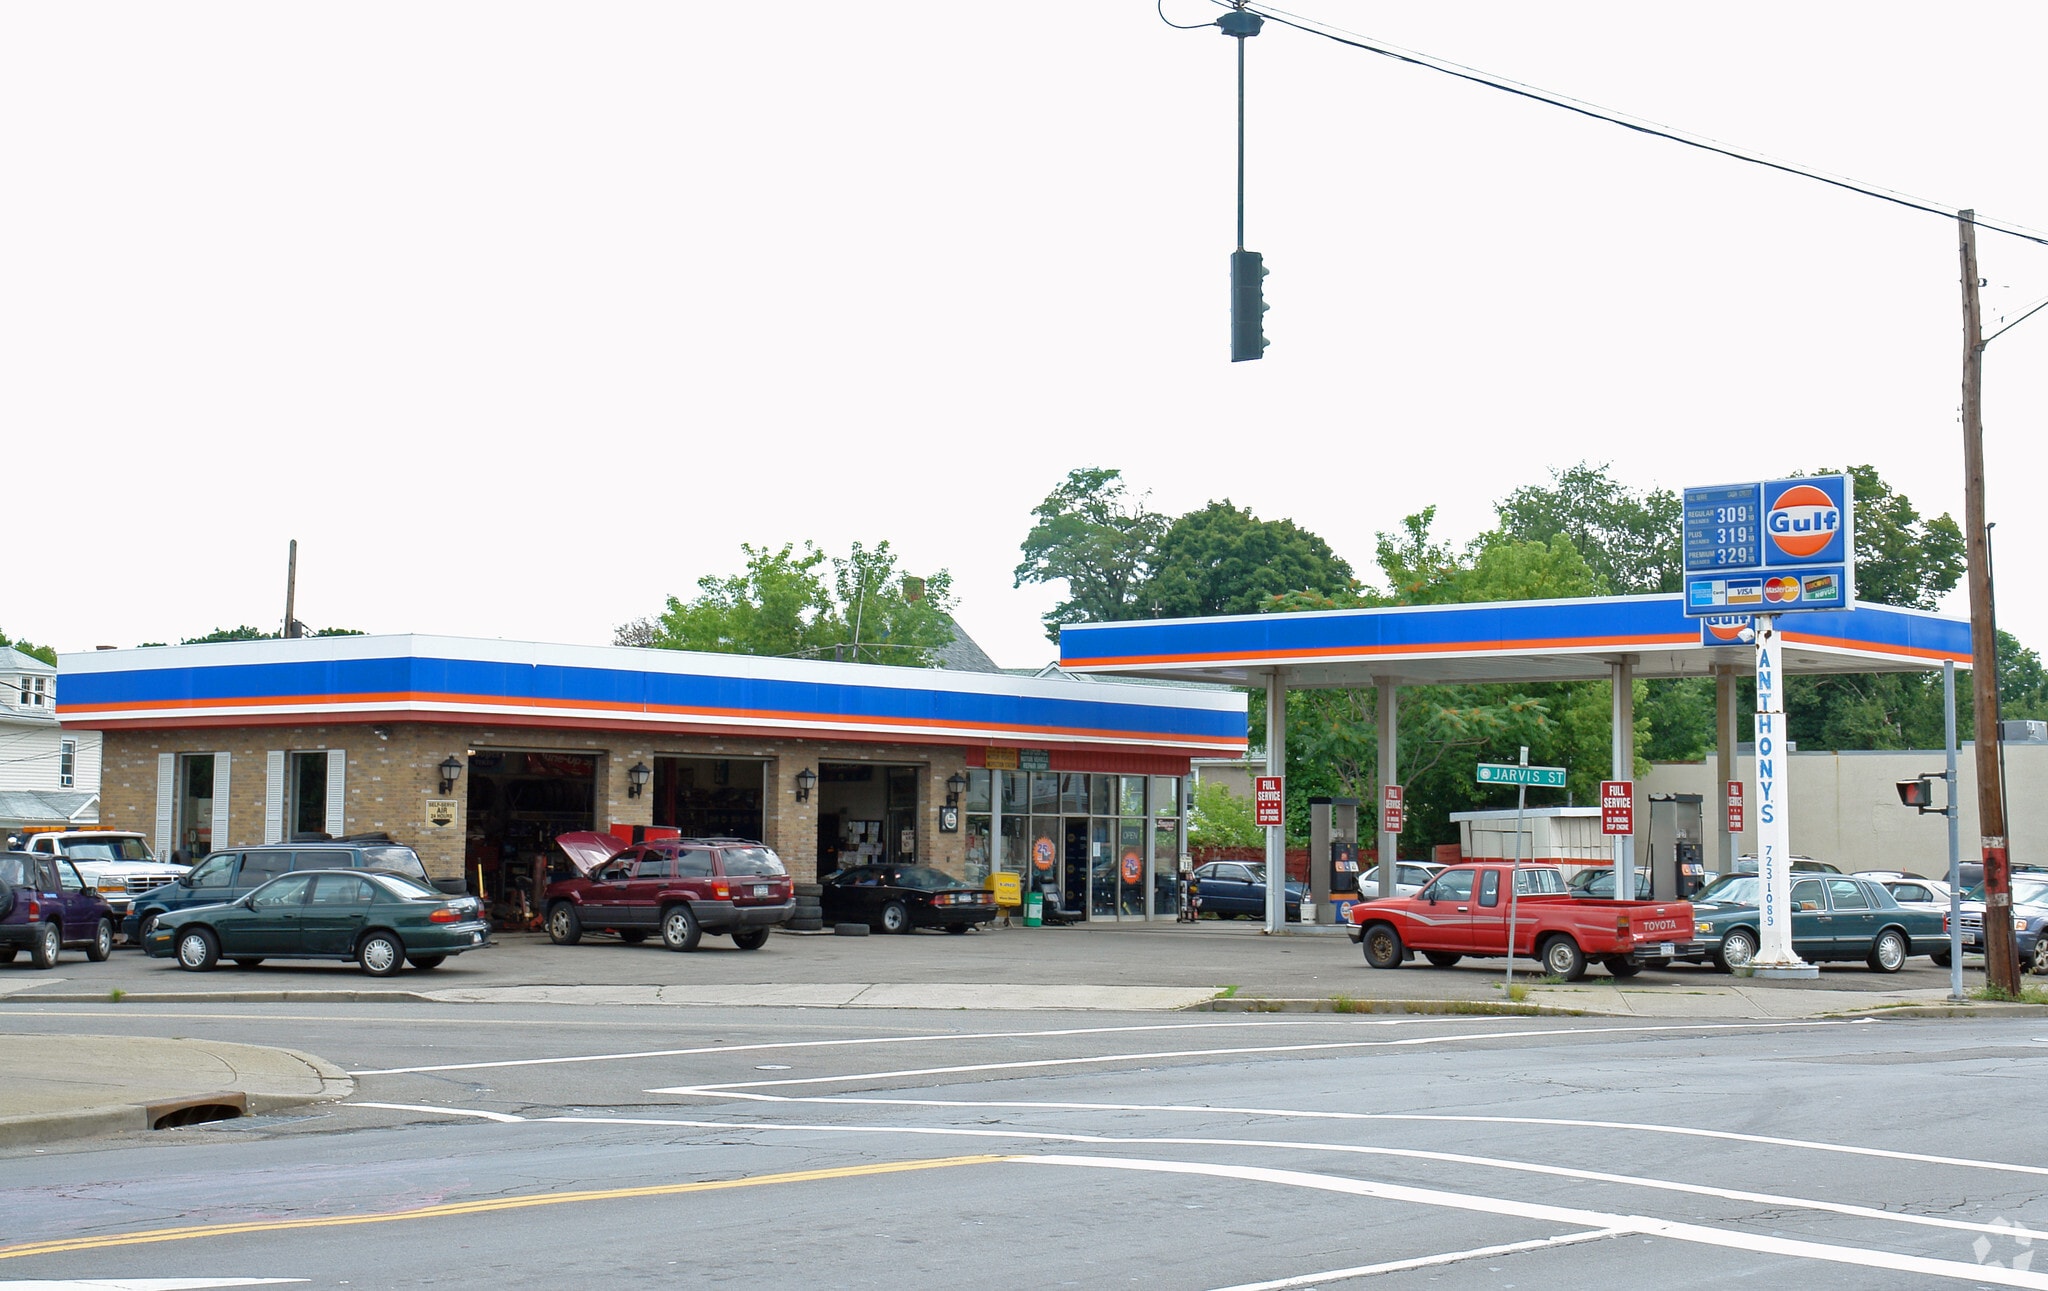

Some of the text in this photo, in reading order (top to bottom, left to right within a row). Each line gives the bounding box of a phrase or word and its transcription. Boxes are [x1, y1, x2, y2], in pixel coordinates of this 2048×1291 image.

[1717, 506, 1746, 523] 309
[1769, 511, 1836, 532] Gulf
[1717, 527, 1746, 543] 319
[1718, 547, 1747, 564] 329
[1765, 585, 1799, 594] MasterCard
[1493, 768, 1564, 784] JARVIS ST
[1262, 780, 1276, 790] FULL
[1609, 785, 1625, 796] FULL
[1257, 791, 1281, 801] SERVICE
[1603, 797, 1631, 808] SERVICE
[1123, 831, 1138, 839] OPEN
[1643, 920, 1676, 931] TOYOTA
